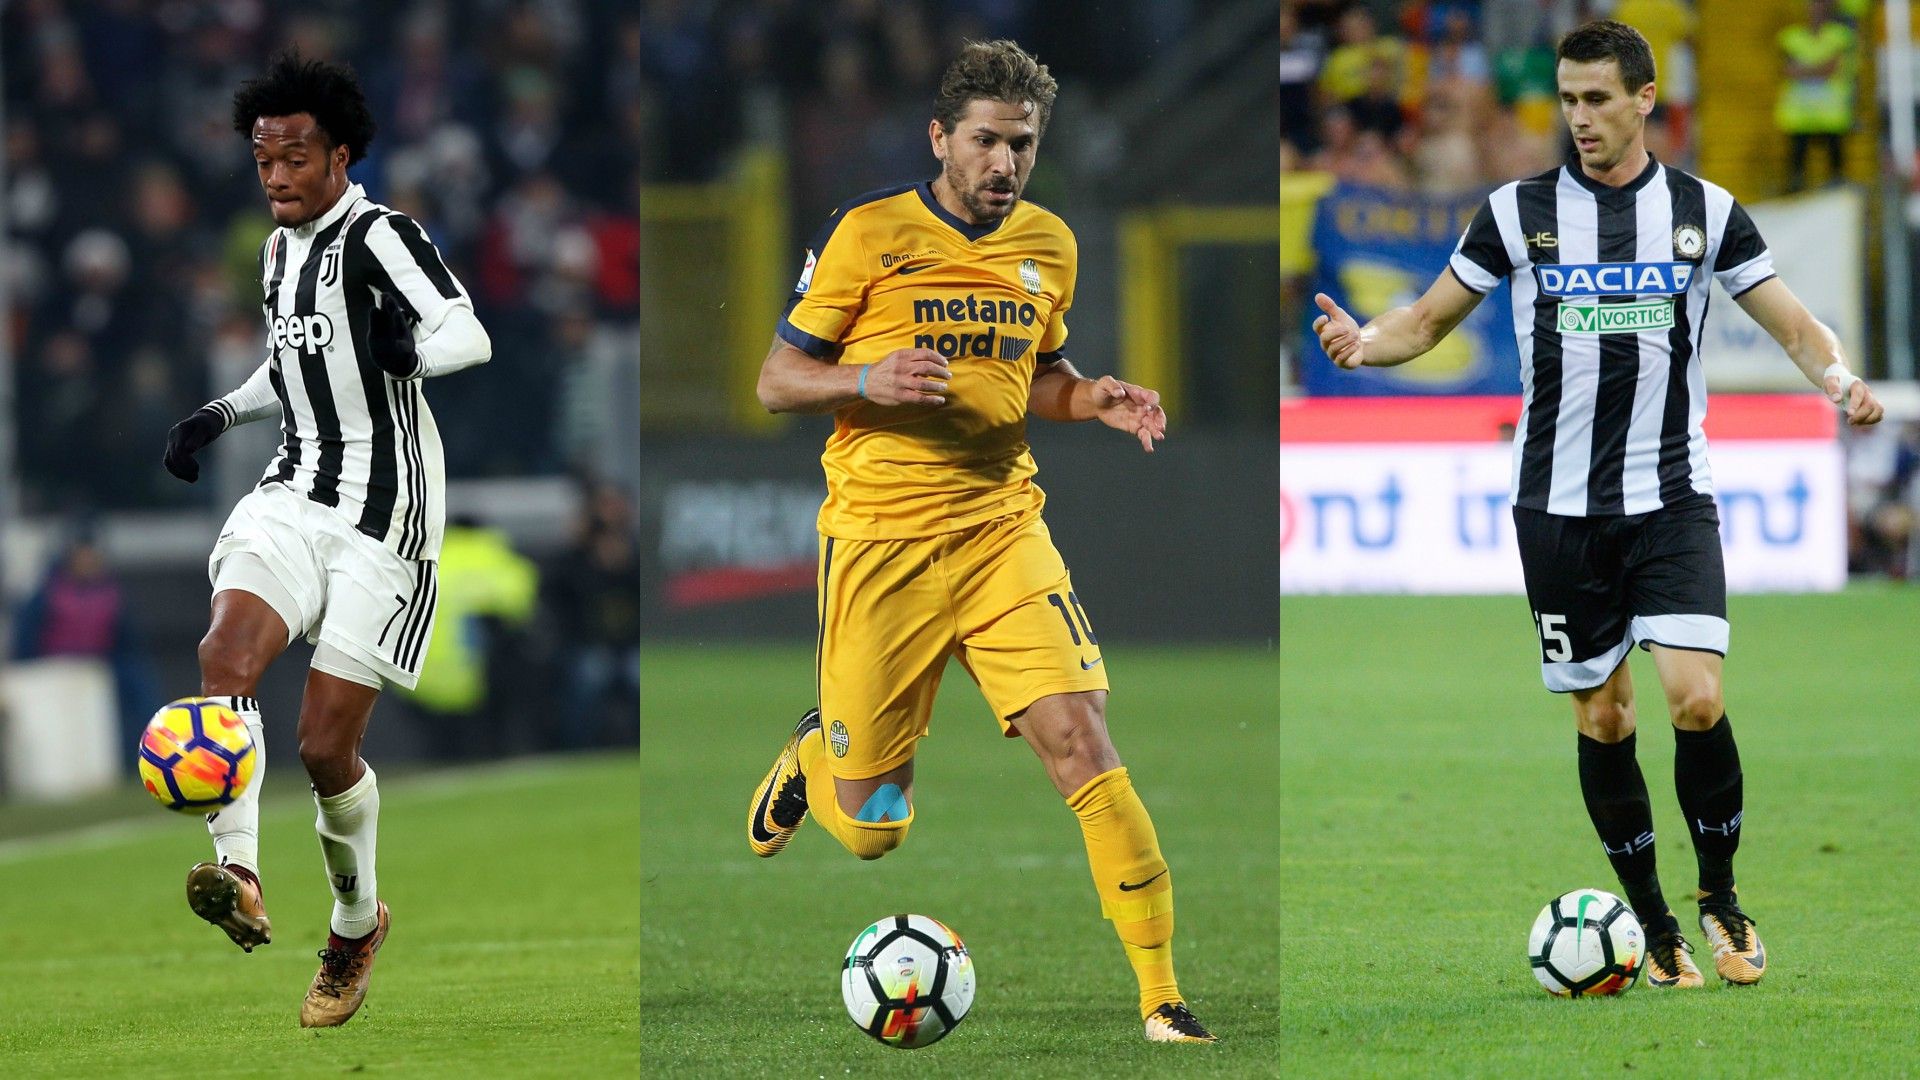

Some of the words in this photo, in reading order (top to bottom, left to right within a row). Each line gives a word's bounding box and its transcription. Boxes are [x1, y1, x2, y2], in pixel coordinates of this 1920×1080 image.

[1523, 231, 1558, 248] HS
[1540, 266, 1666, 292] DACIA
[913, 294, 1036, 327] metano
[1602, 307, 1670, 326] VORTICE
[914, 326, 995, 358] nord
[377, 593, 408, 648] 7
[1603, 831, 1655, 856] HS
